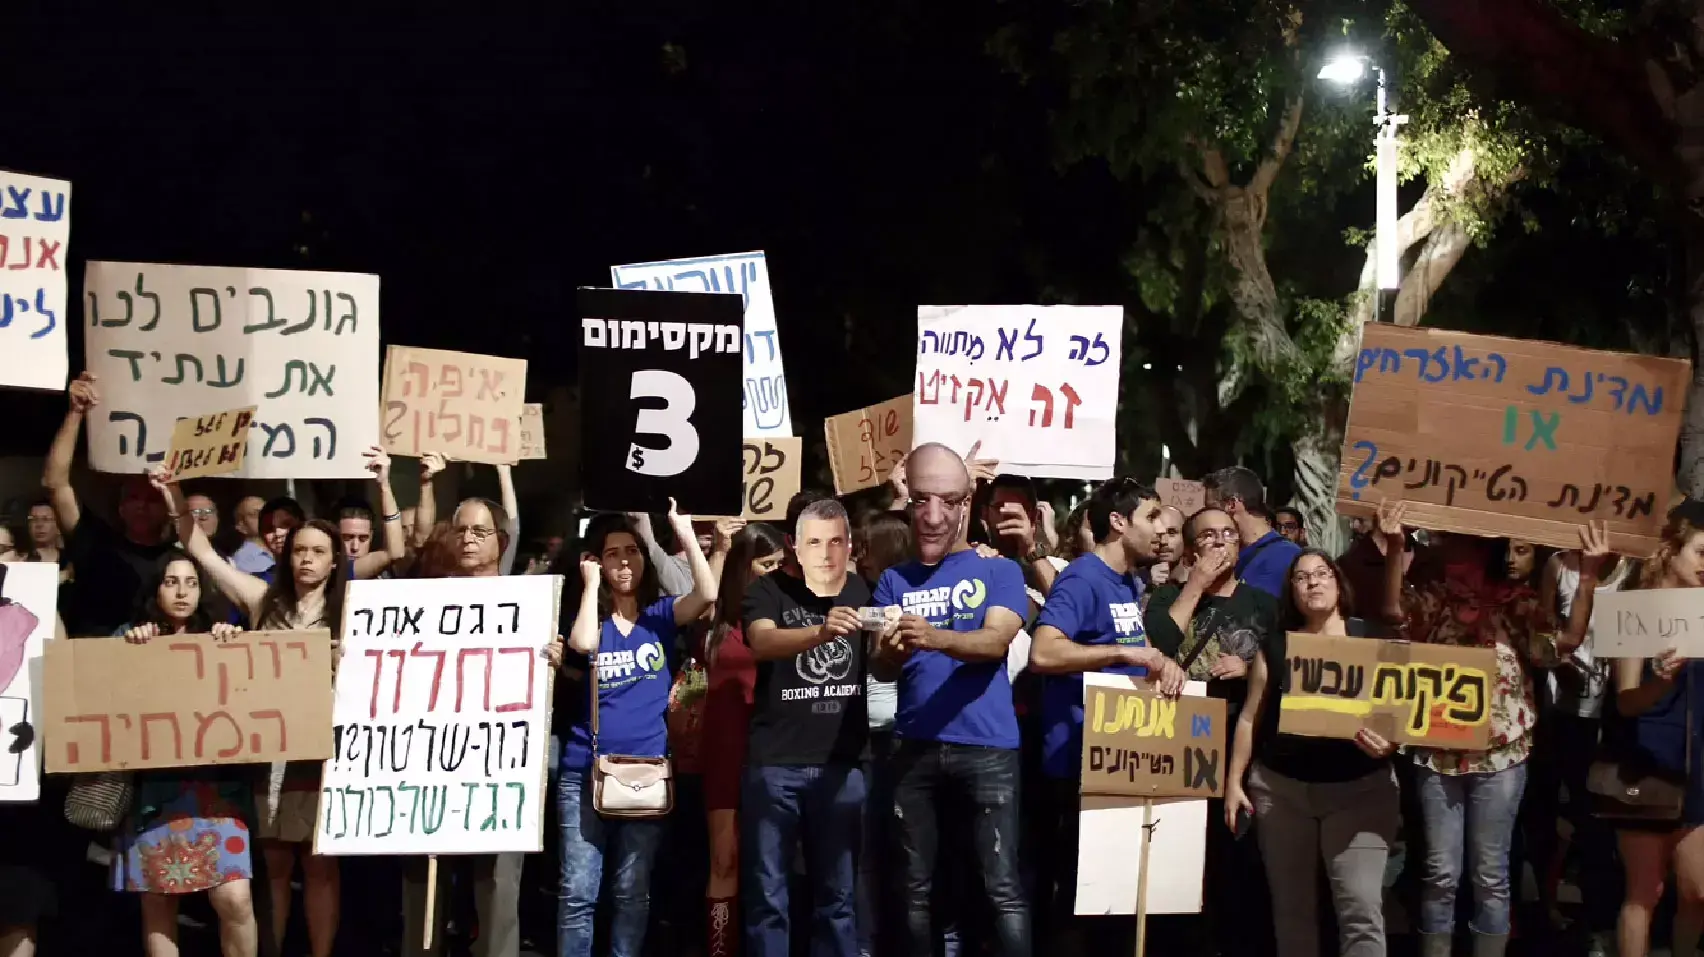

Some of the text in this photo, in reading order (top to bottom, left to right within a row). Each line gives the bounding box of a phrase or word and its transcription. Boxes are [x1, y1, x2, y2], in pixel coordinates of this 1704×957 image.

[0, 184, 64, 222] עצ
[190, 286, 356, 335] גונבים
[582, 318, 741, 360] מקסימום
[996, 318, 1044, 362] לא
[108, 349, 335, 398] את עתיד
[402, 360, 504, 402] איפה
[1527, 367, 1663, 415] מדינת
[625, 369, 699, 477] 3
[1028, 382, 1082, 428] זה
[1503, 405, 1560, 450] או
[1547, 482, 1654, 519] מדינת
[353, 606, 424, 636] אתה
[169, 641, 307, 705] יוקר
[365, 642, 534, 721] כחלון
[781, 683, 862, 700] BOXING ACADEMY
[1092, 691, 1176, 739] אנחנו
[1373, 665, 1487, 733] פיקוח
[65, 709, 287, 764] המחיה
[1183, 745, 1218, 792] או
